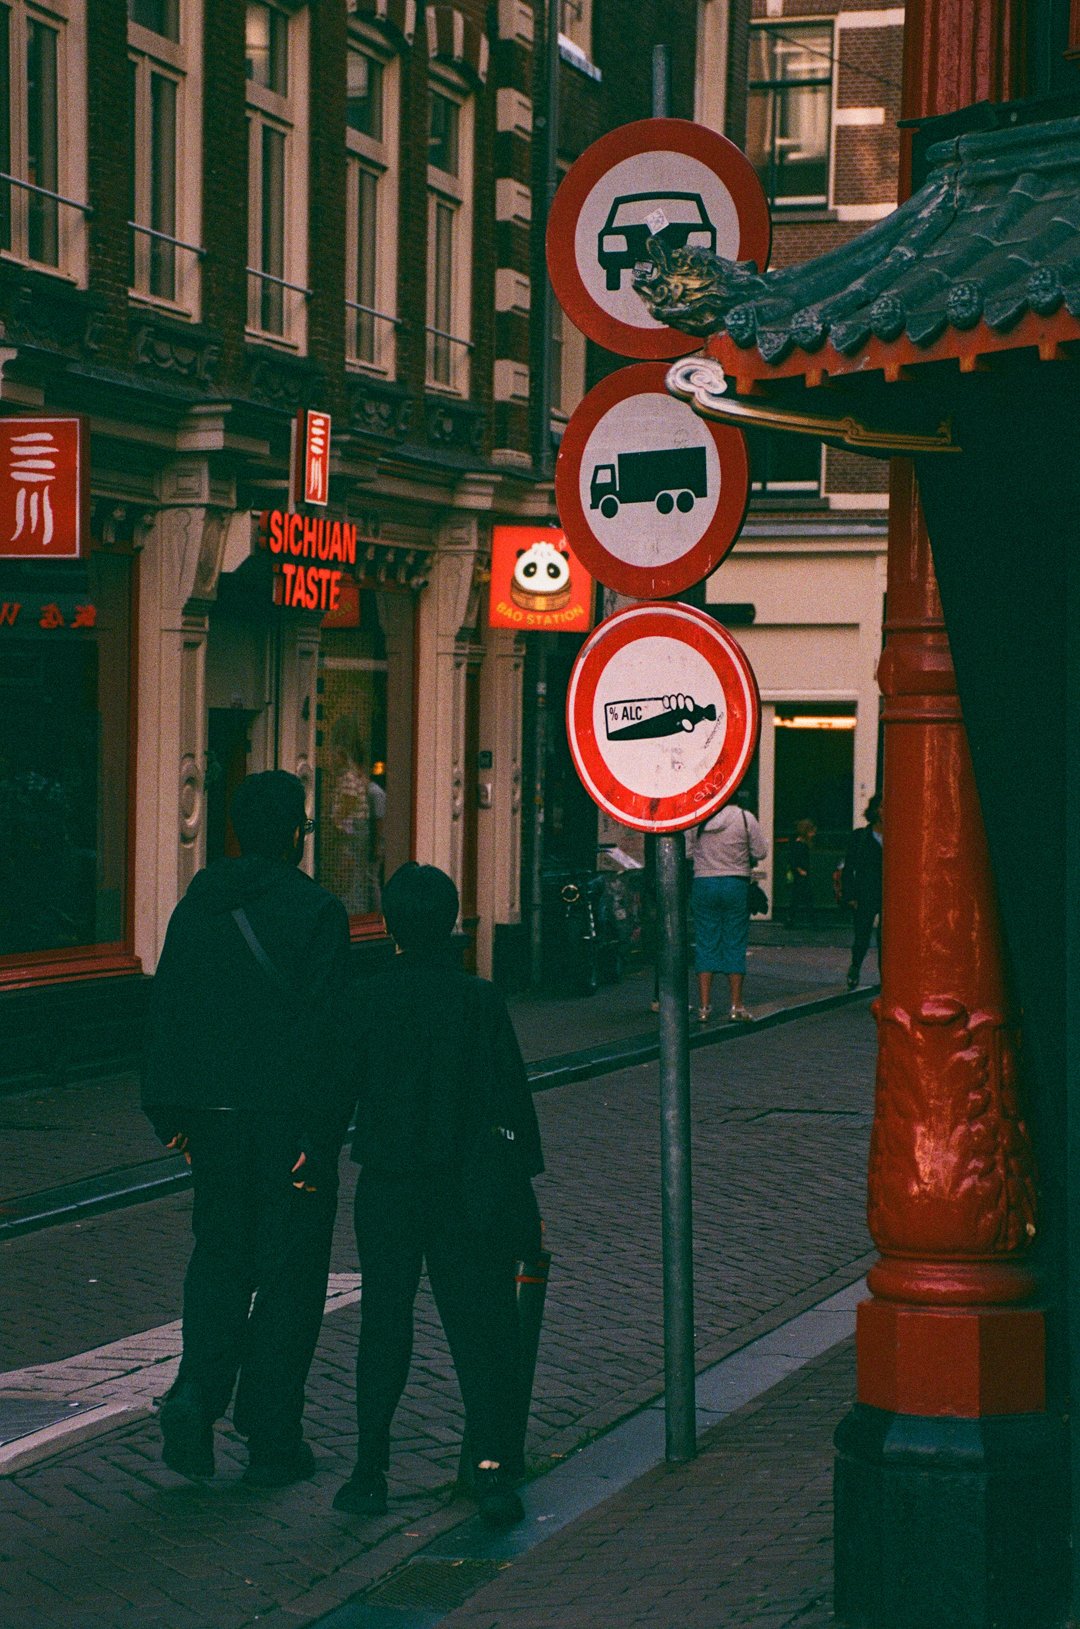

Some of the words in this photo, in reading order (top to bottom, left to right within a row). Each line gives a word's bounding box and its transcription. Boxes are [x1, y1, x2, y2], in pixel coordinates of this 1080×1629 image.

[269, 509, 357, 565] SICHUAN
[282, 563, 342, 611] TASTE
[496, 602, 523, 622] BAO
[526, 604, 585, 625] STATION
[621, 706, 643, 721] ALC
